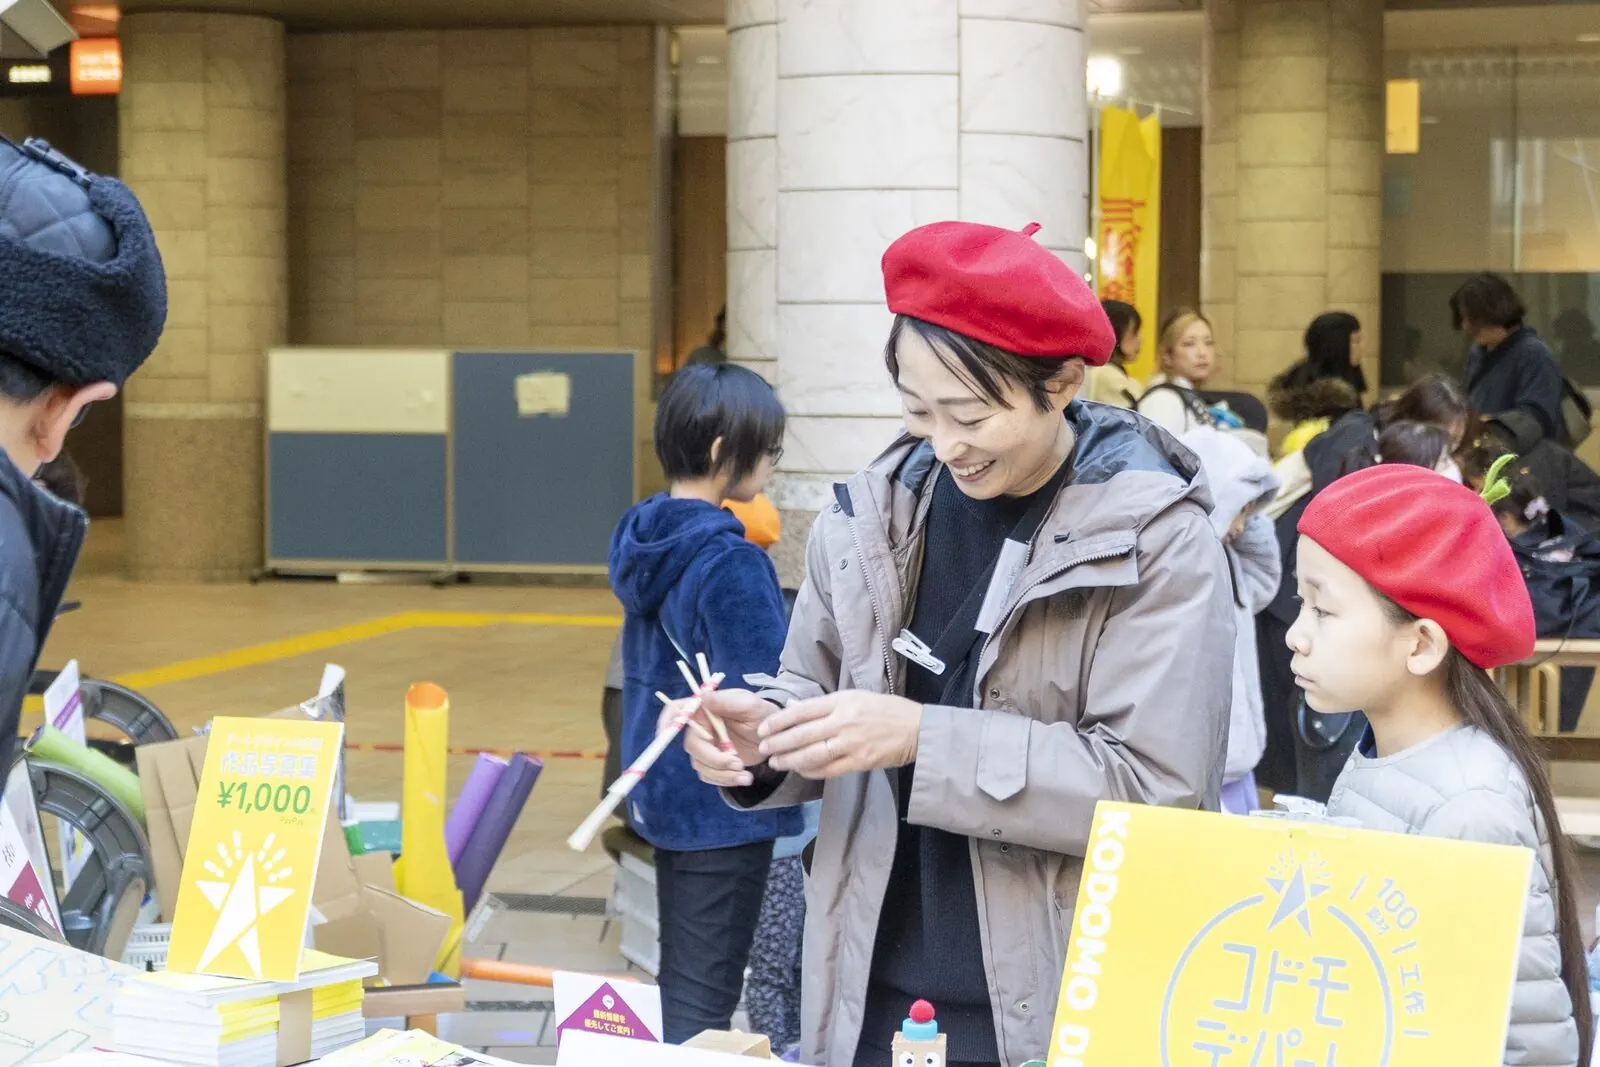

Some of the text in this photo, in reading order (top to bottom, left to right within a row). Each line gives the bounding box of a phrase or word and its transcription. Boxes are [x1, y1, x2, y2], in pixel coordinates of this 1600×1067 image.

[220, 750, 318, 780] 作品写真集
[216, 781, 311, 814] ¥1,000
[1066, 810, 1132, 1012] KODOMO
[1376, 877, 1418, 930] 100
[1213, 942, 1349, 1027] コドモ
[1399, 963, 1426, 1015] 工作
